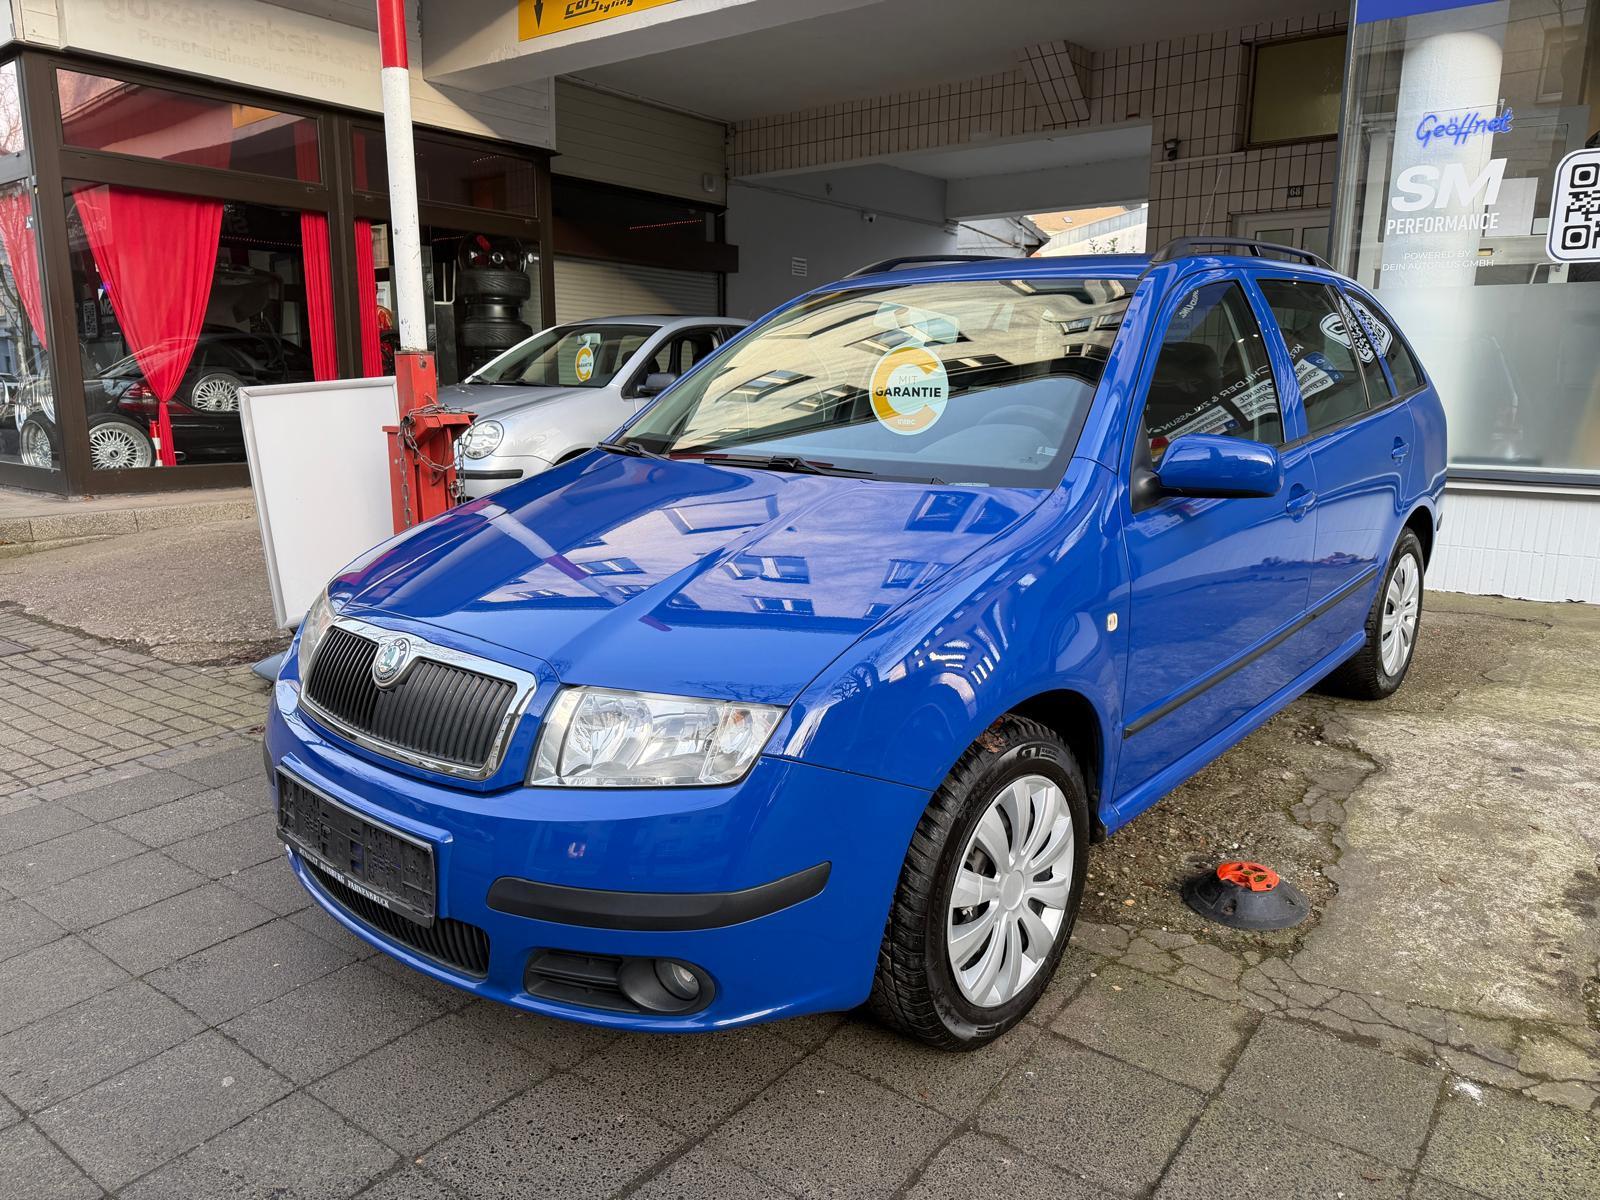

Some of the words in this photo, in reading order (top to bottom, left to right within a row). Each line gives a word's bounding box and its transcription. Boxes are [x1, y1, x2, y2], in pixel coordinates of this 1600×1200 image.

[1416, 107, 1513, 148] Geöffnet
[1391, 157, 1508, 212] SM
[1386, 212, 1500, 236] PERFORMANCE
[1382, 263, 1406, 272] DEIN
[898, 375, 918, 385] MIT
[875, 387, 942, 398] GARANTIE
